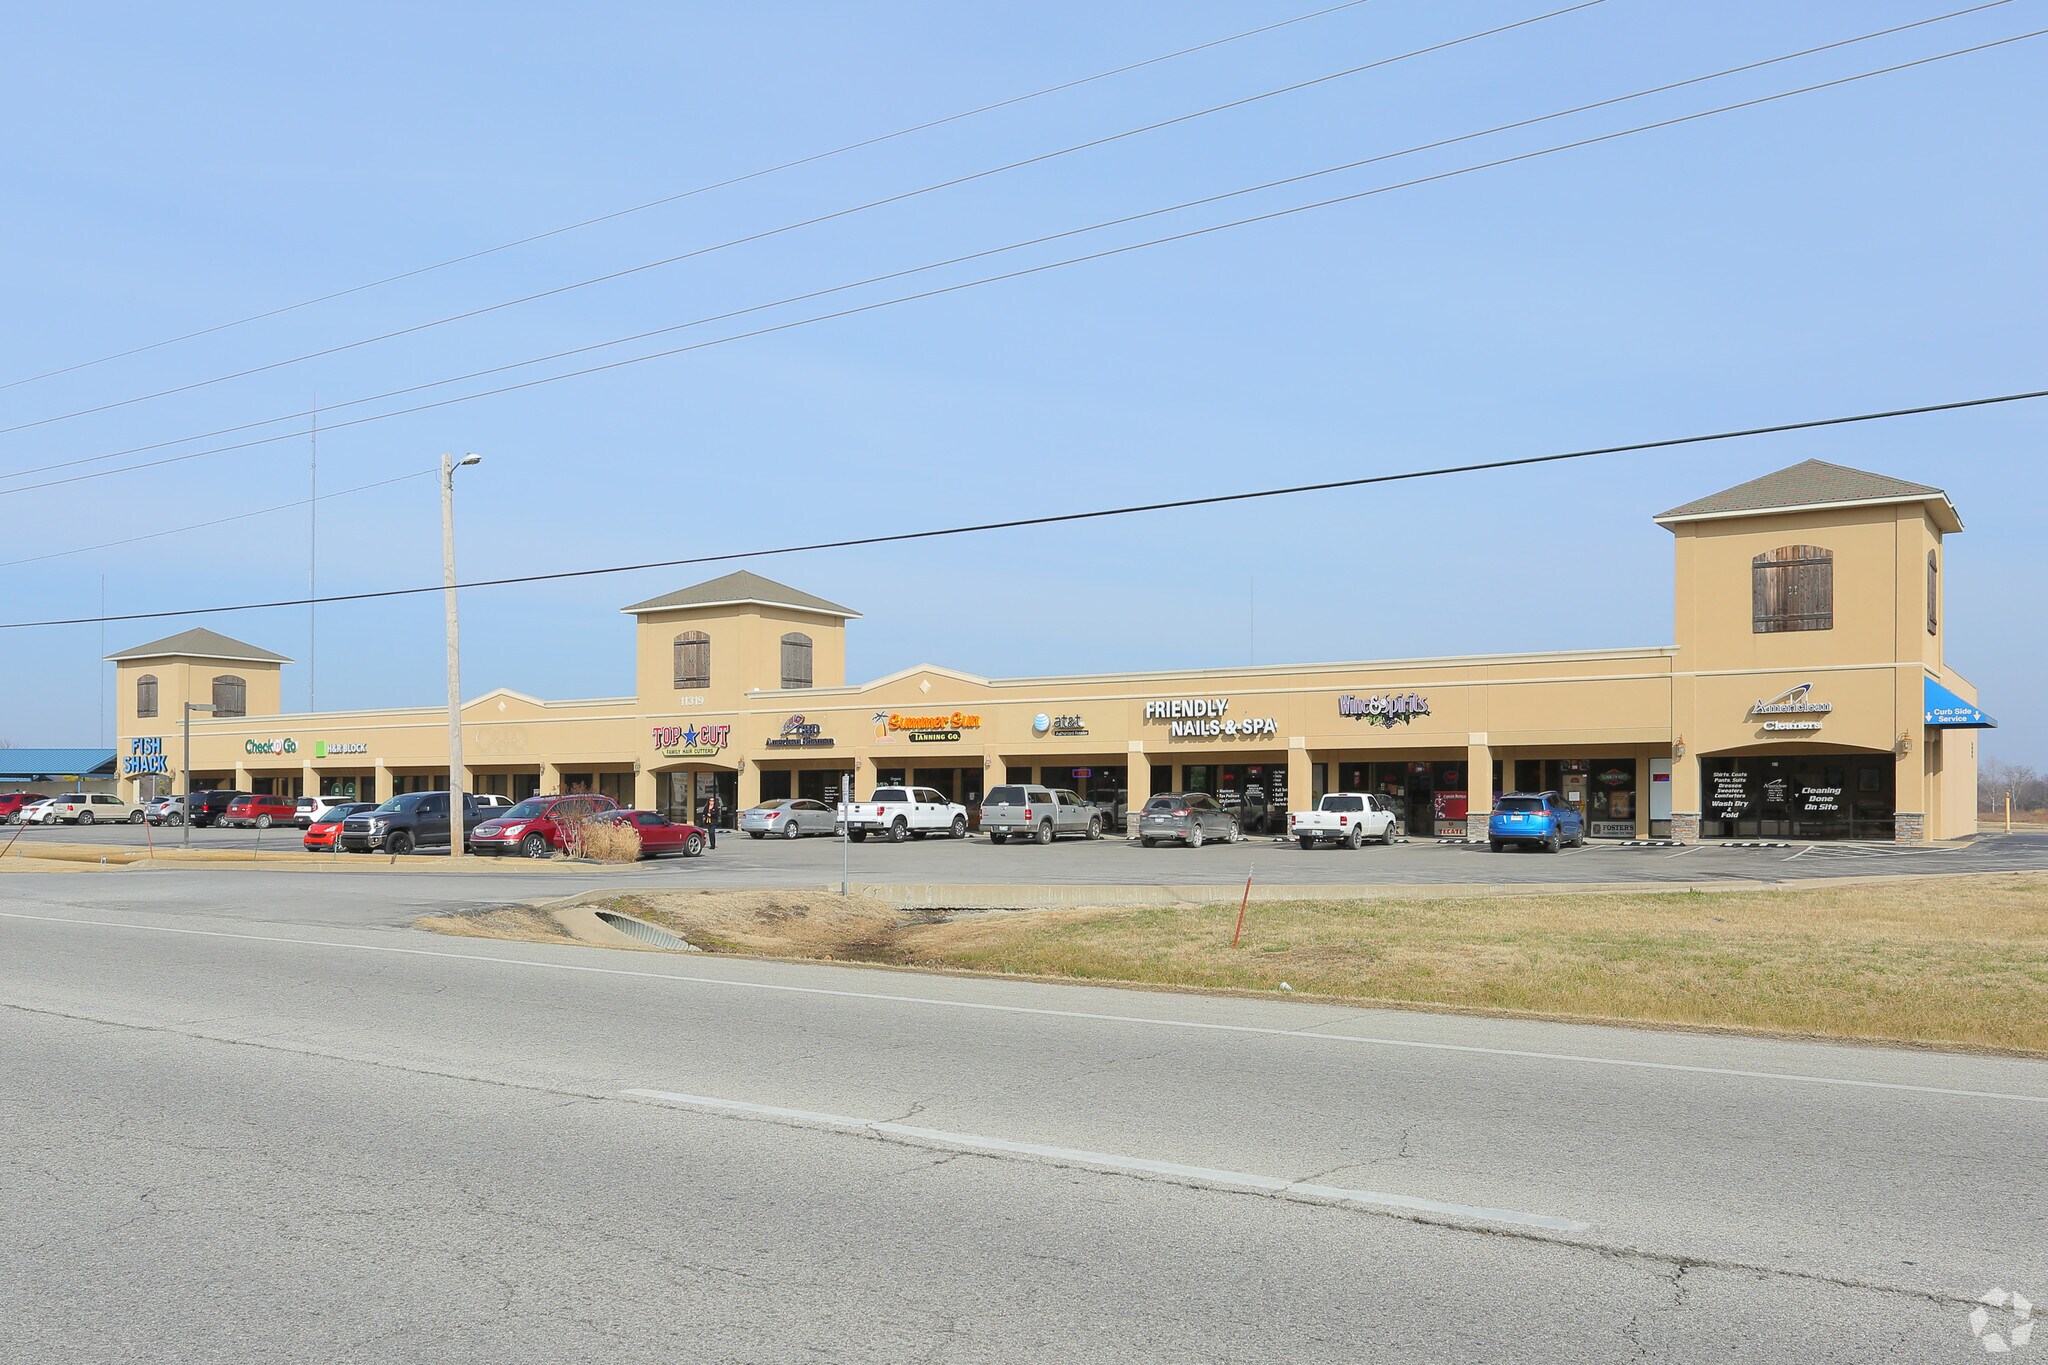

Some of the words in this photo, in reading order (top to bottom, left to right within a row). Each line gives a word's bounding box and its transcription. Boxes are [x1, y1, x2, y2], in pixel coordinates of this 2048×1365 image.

[1145, 698, 1229, 719] FRIENDLY
[1339, 694, 1370, 715] Wine
[1381, 692, 1429, 718] Spirits
[1933, 708, 1953, 716] Curb
[1954, 707, 1972, 715] Side
[888, 713, 949, 731] Summer
[950, 710, 981, 729] Sun
[1053, 713, 1083, 728] at&t
[1171, 719, 1221, 737] NAILS
[1225, 719, 1238, 736] &
[1242, 717, 1278, 735] SPA
[1763, 720, 1823, 731] Cleaners
[131, 736, 162, 755] FISH
[652, 726, 682, 750] TOP
[699, 724, 731, 749] CUT
[910, 732, 946, 741] TANNING
[245, 738, 273, 755] Check
[283, 737, 297, 754] Go
[327, 743, 344, 755] H&R
[344, 743, 367, 755] BLOCK
[123, 754, 169, 774] SHACK
[1801, 787, 1842, 796] Cleaning
